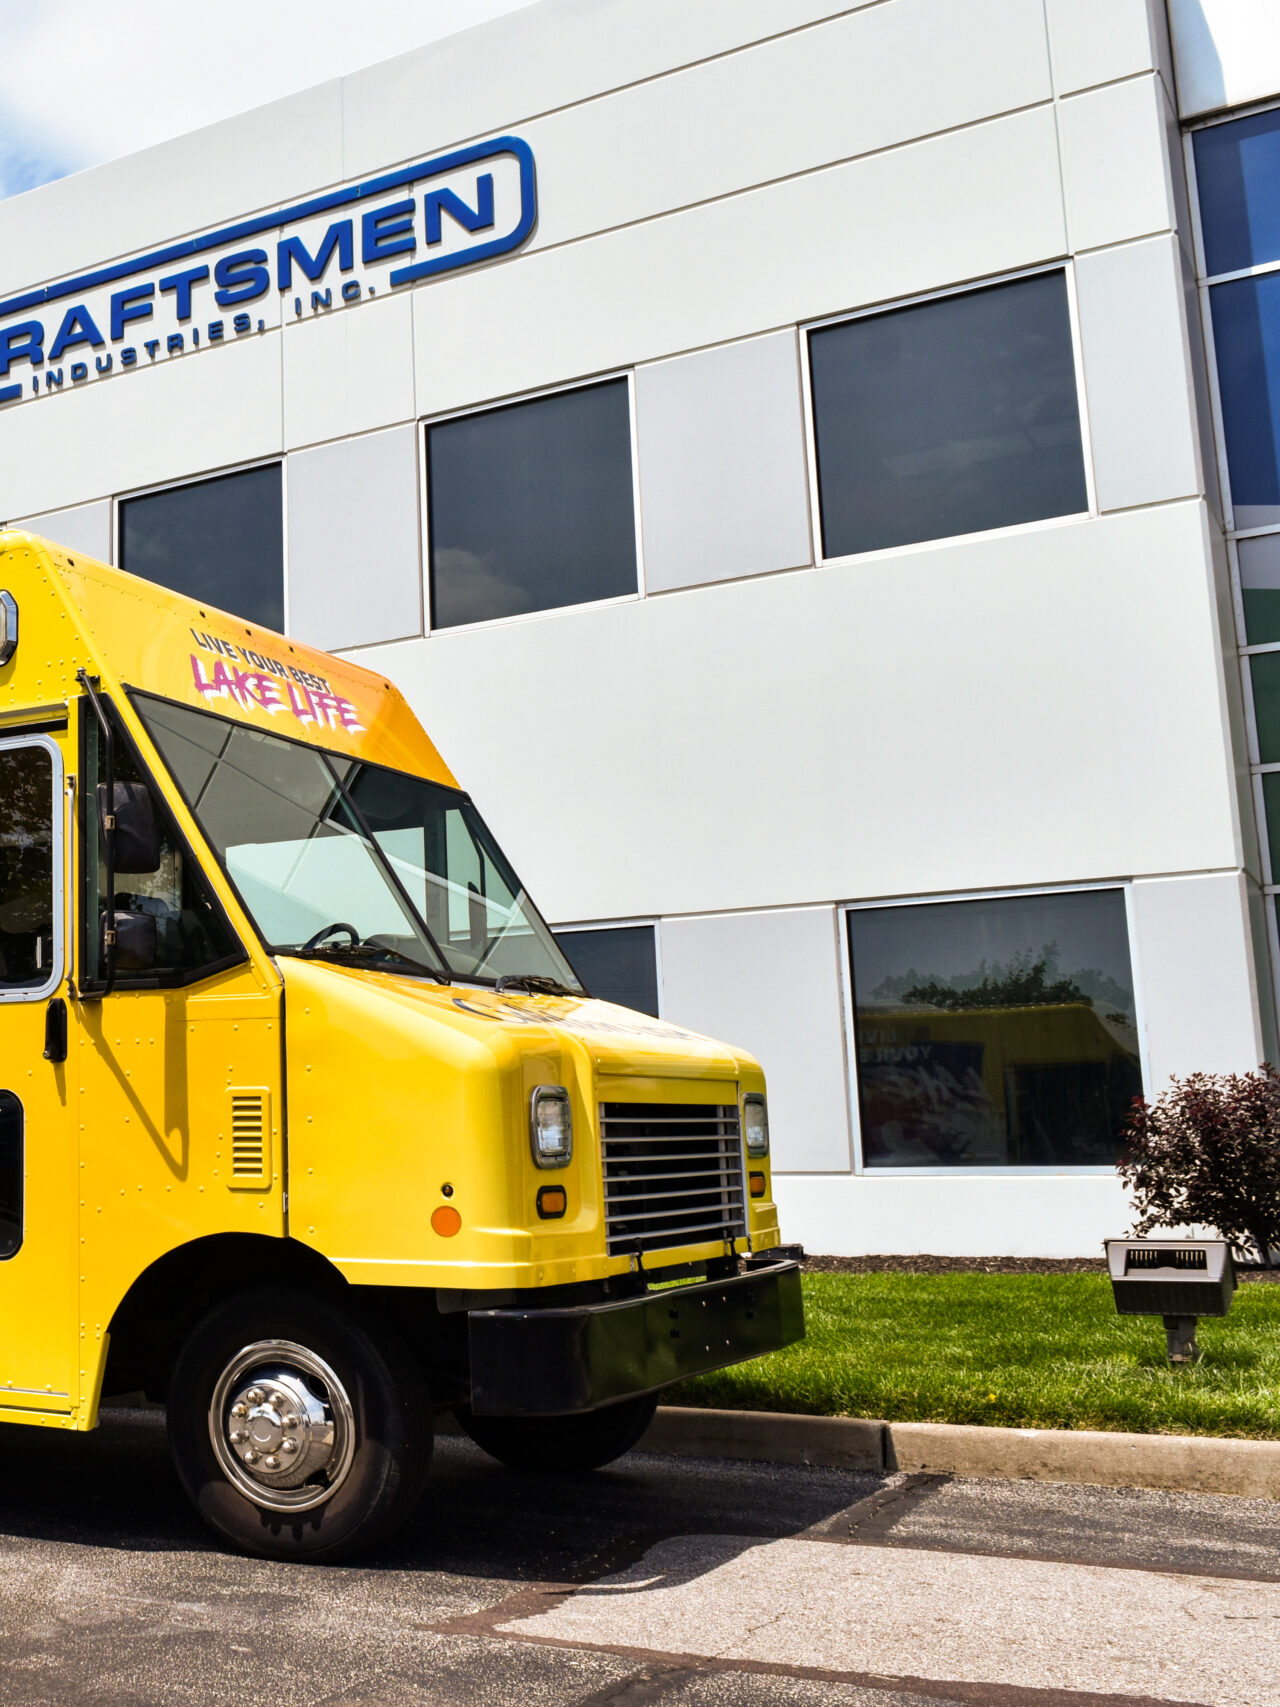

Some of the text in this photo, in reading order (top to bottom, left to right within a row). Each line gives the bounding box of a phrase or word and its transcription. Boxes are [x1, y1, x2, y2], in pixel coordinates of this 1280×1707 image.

[32, 279, 376, 392] INDUSTRIES, INC.
[190, 627, 334, 696] LIVE YOUR BEST
[190, 653, 368, 735] LAKE LIFE
